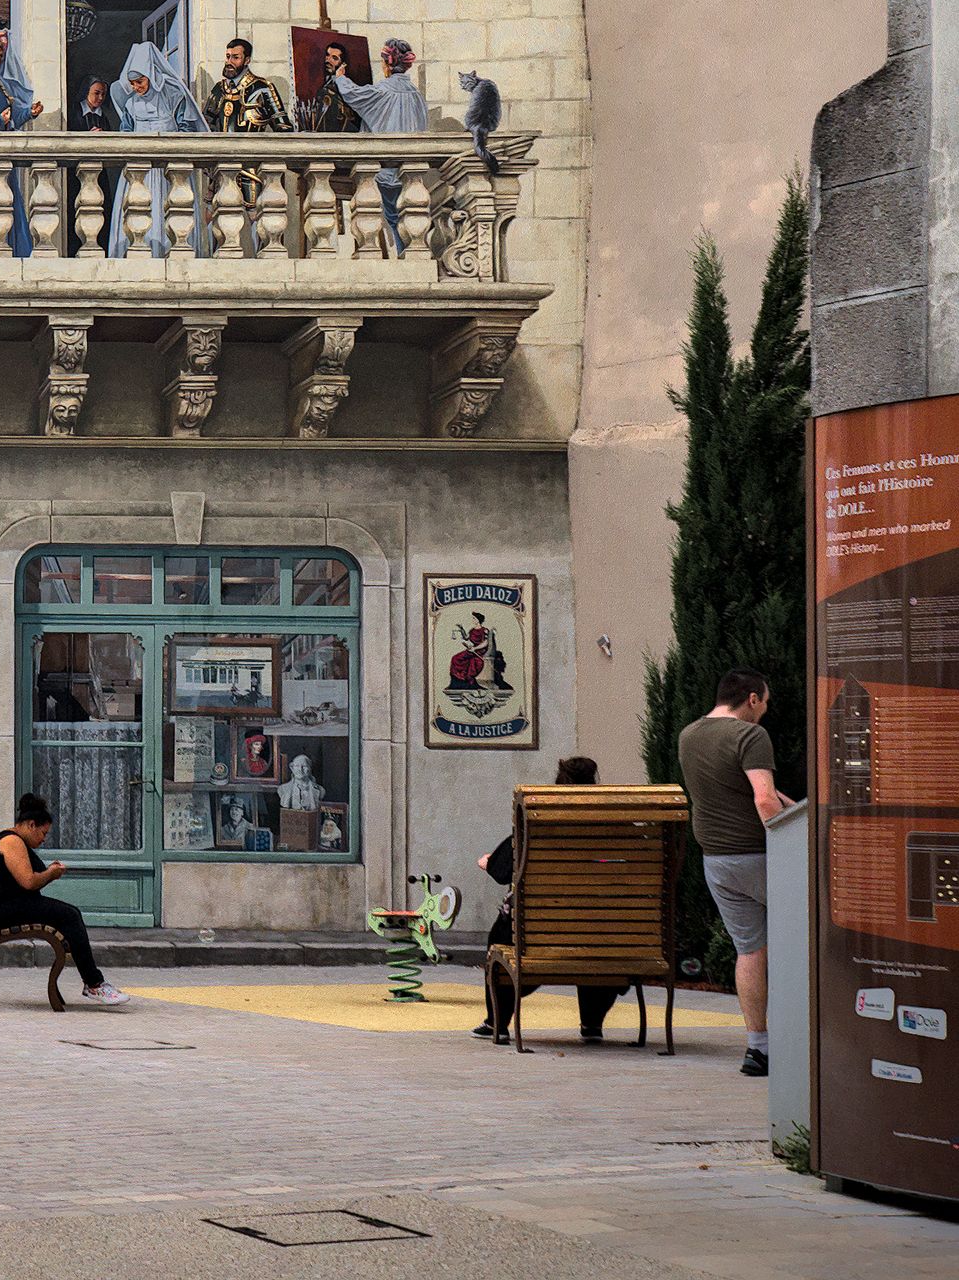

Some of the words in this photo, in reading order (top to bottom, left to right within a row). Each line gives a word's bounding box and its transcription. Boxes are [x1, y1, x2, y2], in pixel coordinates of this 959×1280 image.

[883, 460, 896, 471] et
[897, 458, 917, 470] ces
[858, 480, 876, 495] fait
[878, 475, 934, 492] l'Histoire
[852, 528, 868, 538] and
[868, 527, 887, 537] men
[888, 523, 909, 535] who
[910, 519, 952, 533] marked
[443, 586, 473, 604] BLEU
[476, 585, 513, 604] DALOZ
[448, 724, 456, 734] A
[458, 725, 471, 736] LA
[472, 723, 513, 737] JUSTICE
